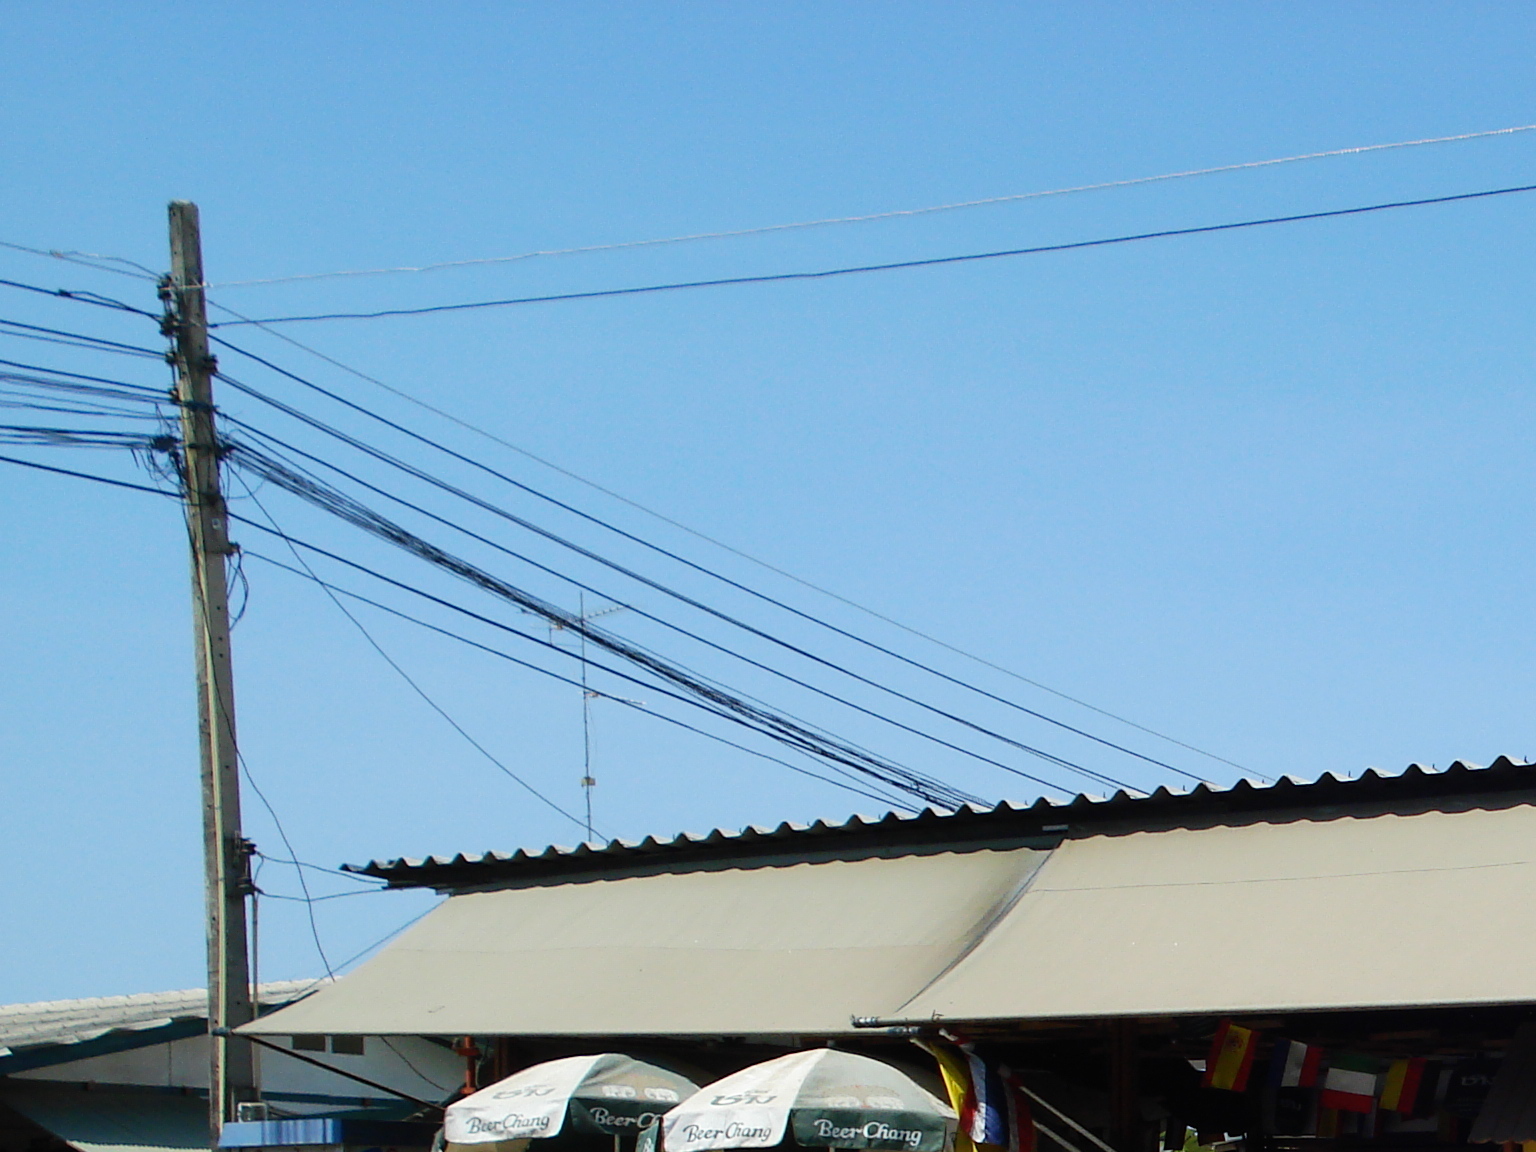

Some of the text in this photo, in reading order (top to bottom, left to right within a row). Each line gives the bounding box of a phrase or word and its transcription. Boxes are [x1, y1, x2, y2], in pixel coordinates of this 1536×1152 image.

[466, 1113, 550, 1134] Beer Chang
[590, 1107, 638, 1127] Beer
[683, 1122, 772, 1143] Beer Chang
[813, 1118, 922, 1146] Beer Chang
